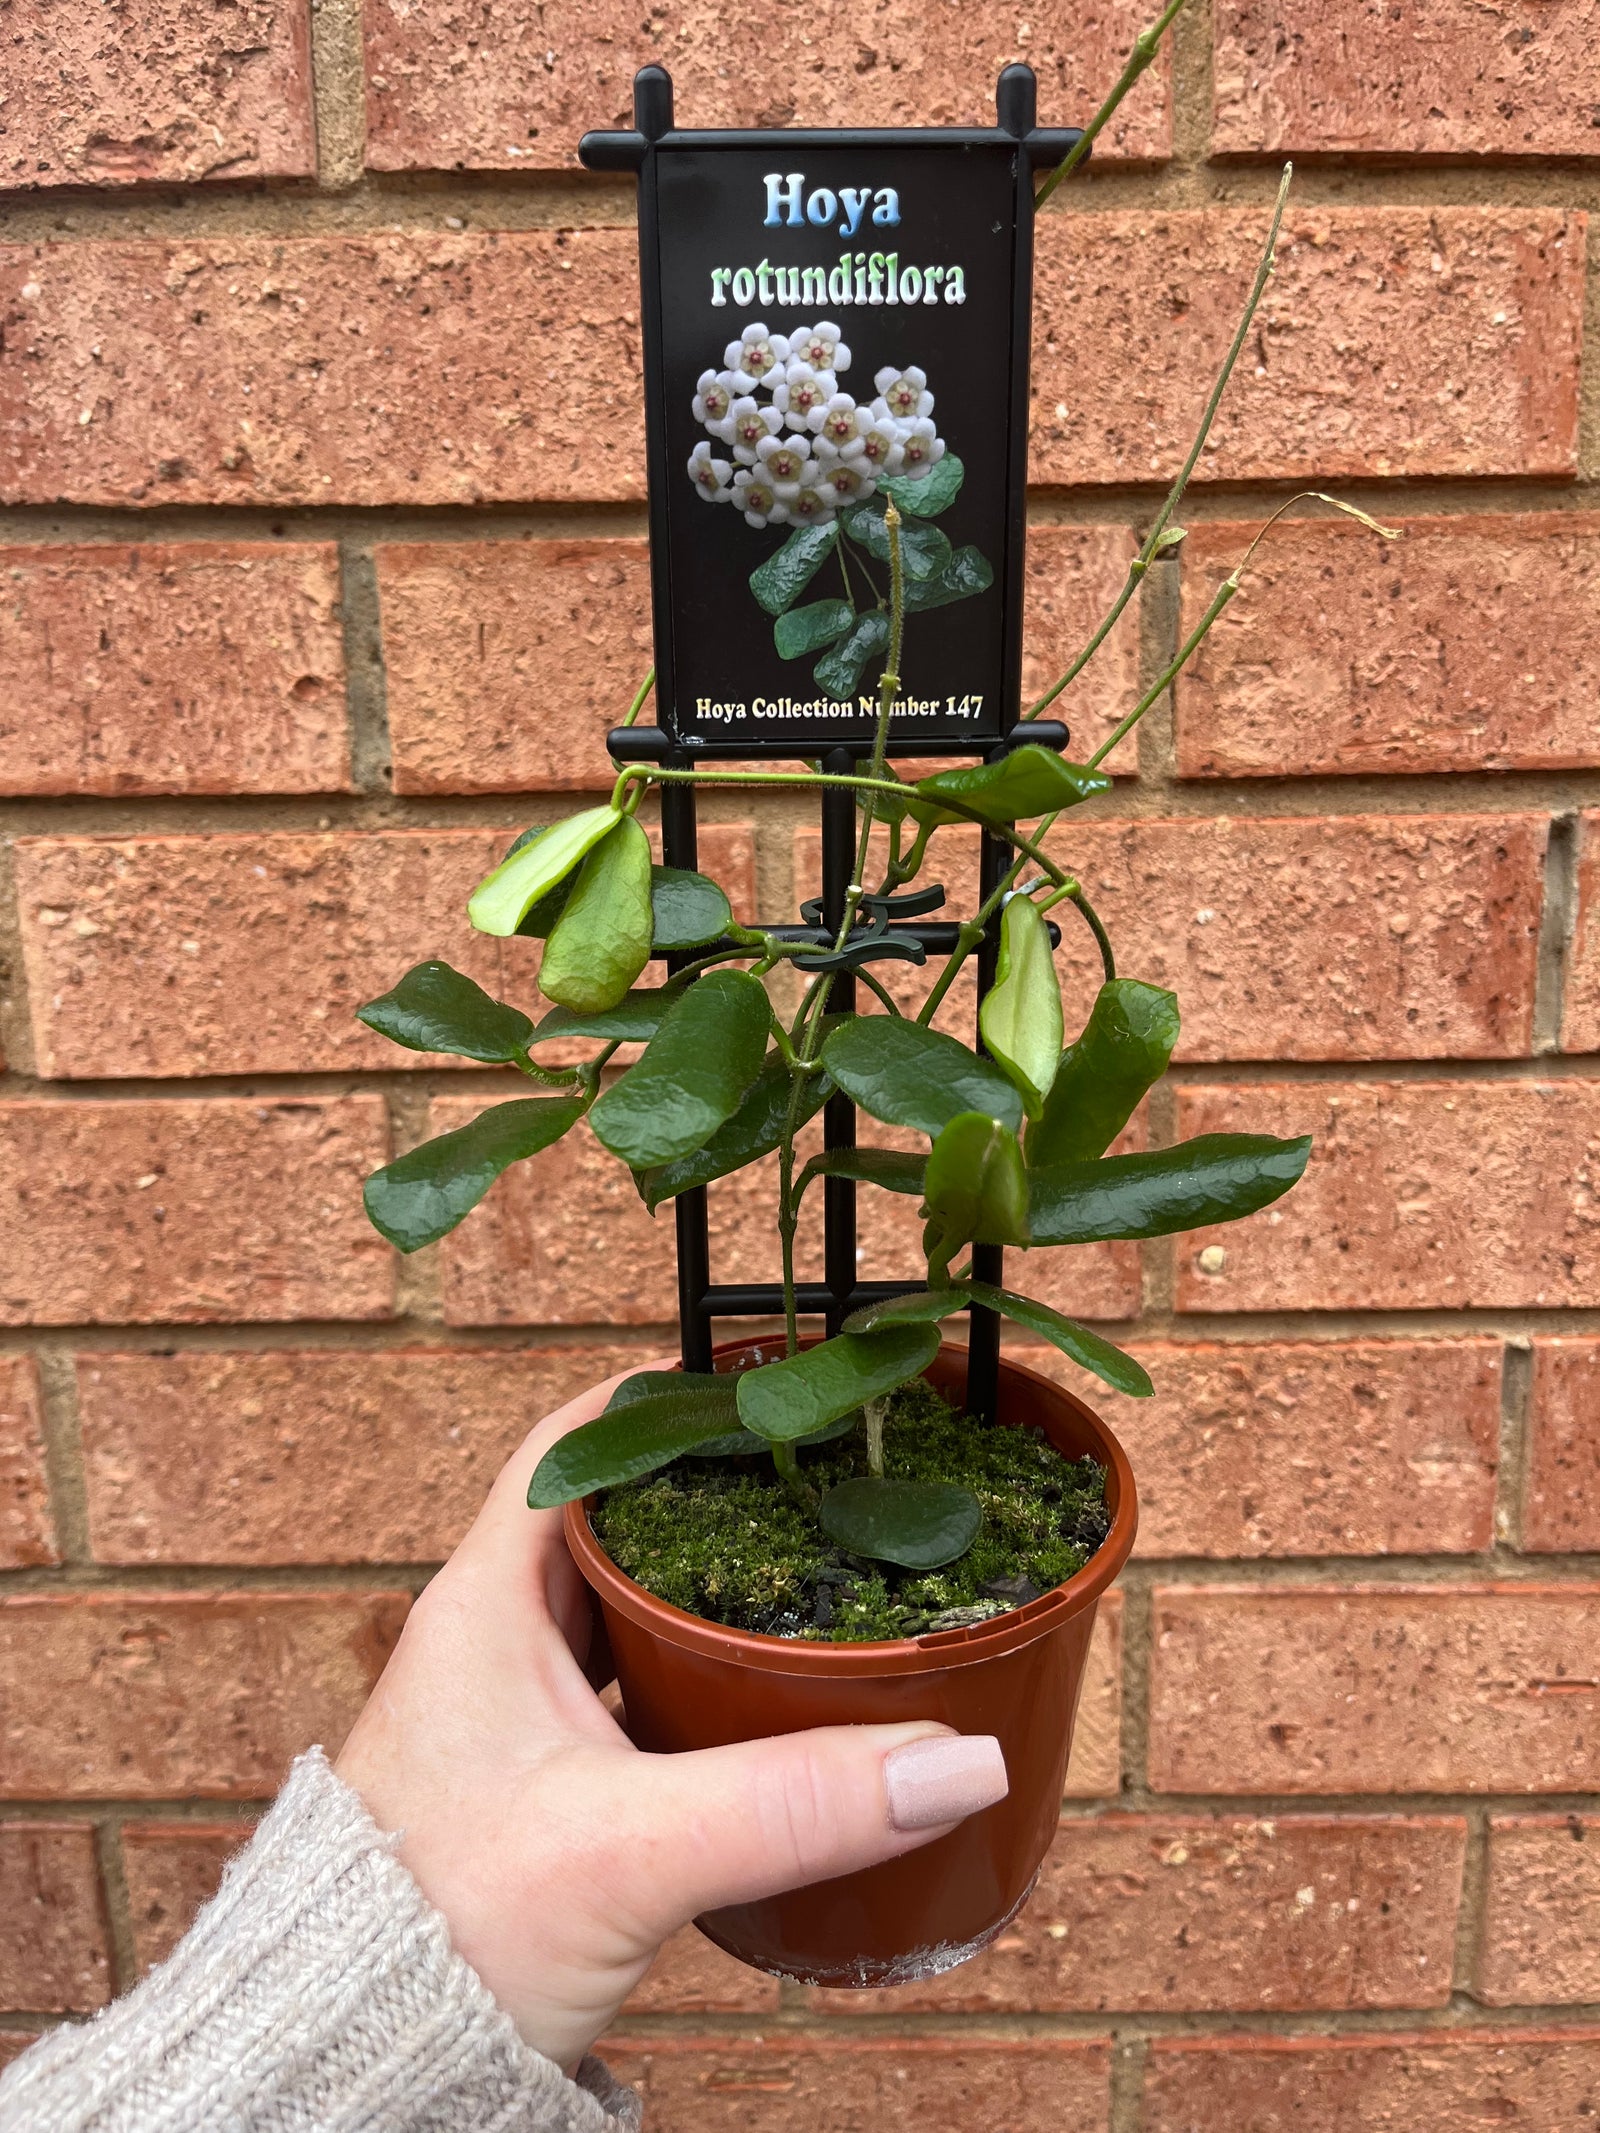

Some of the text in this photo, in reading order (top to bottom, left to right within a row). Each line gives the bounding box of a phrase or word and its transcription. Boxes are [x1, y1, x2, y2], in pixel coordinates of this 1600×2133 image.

[762, 172, 902, 239] Hoya
[710, 252, 967, 307] rotundiflora
[695, 697, 747, 724] Hoya
[751, 696, 854, 719] Collection
[945, 694, 985, 719] 147
